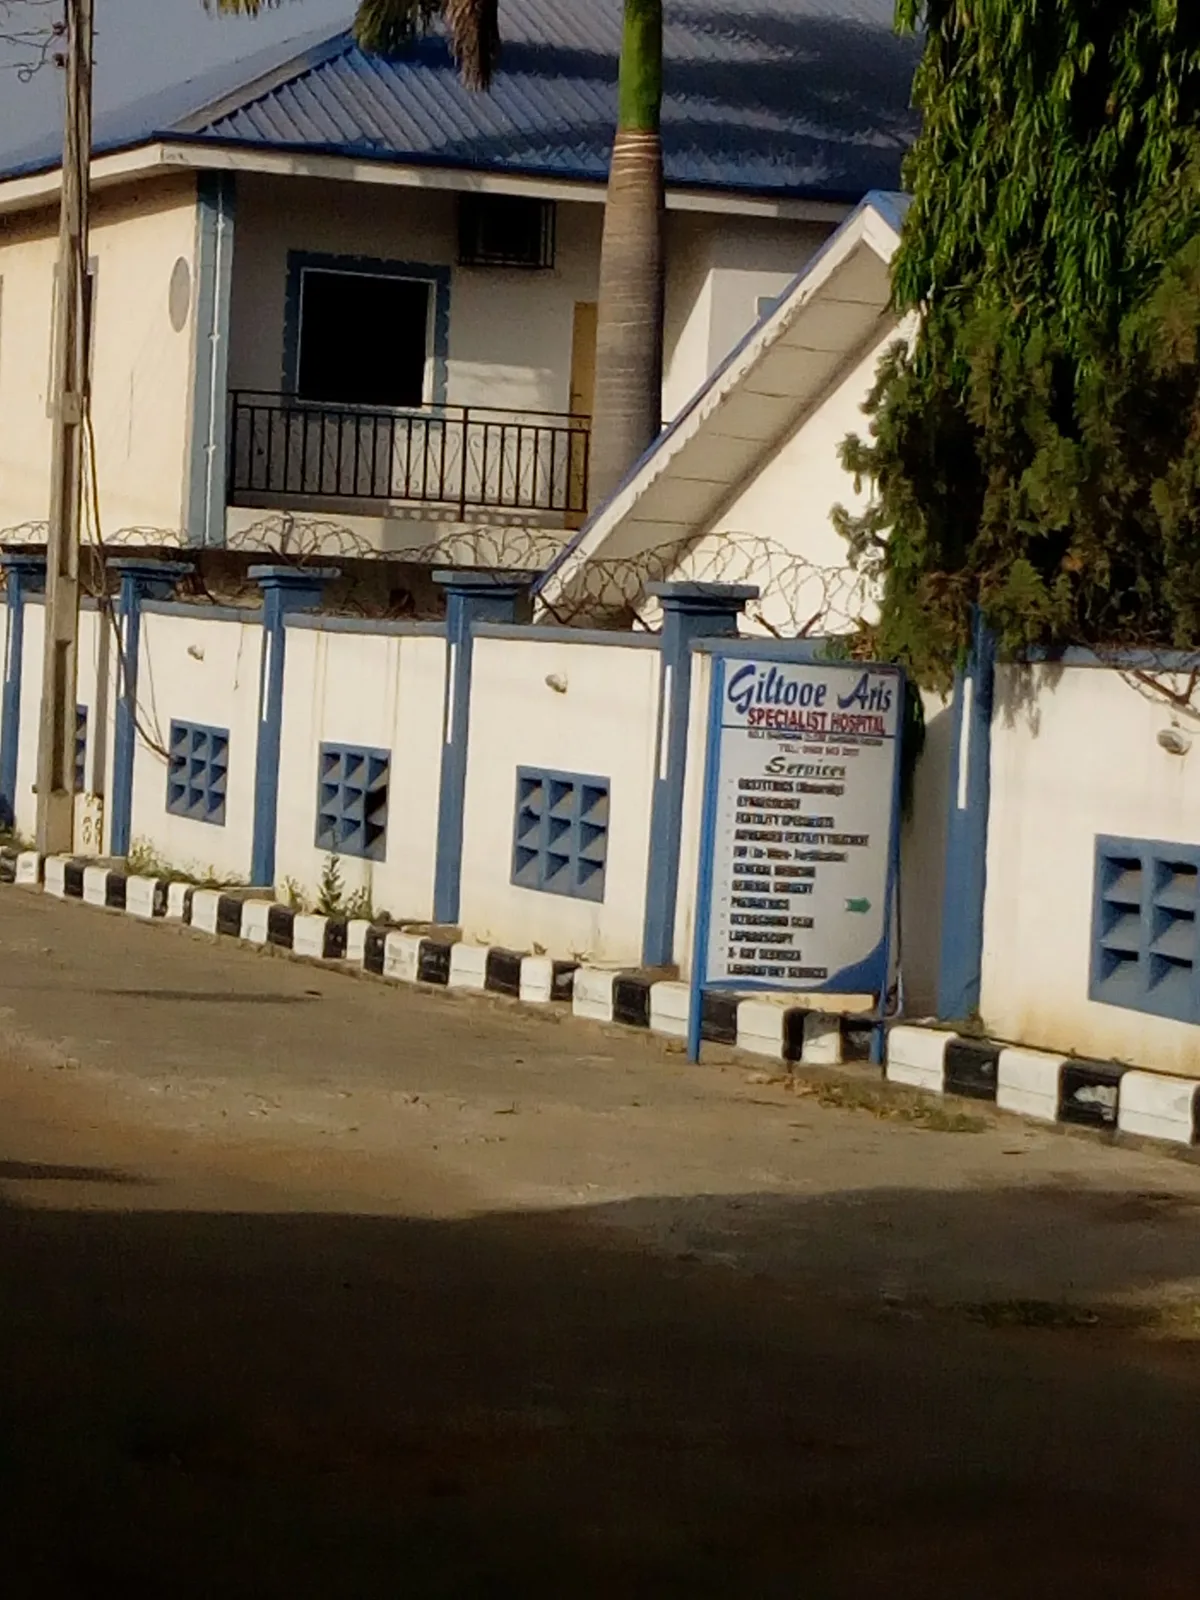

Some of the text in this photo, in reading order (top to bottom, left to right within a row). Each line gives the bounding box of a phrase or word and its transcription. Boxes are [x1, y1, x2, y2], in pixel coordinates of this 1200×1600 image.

[747, 708, 885, 735] SPECIALIST HOSPITAL
[765, 756, 846, 777] Services
